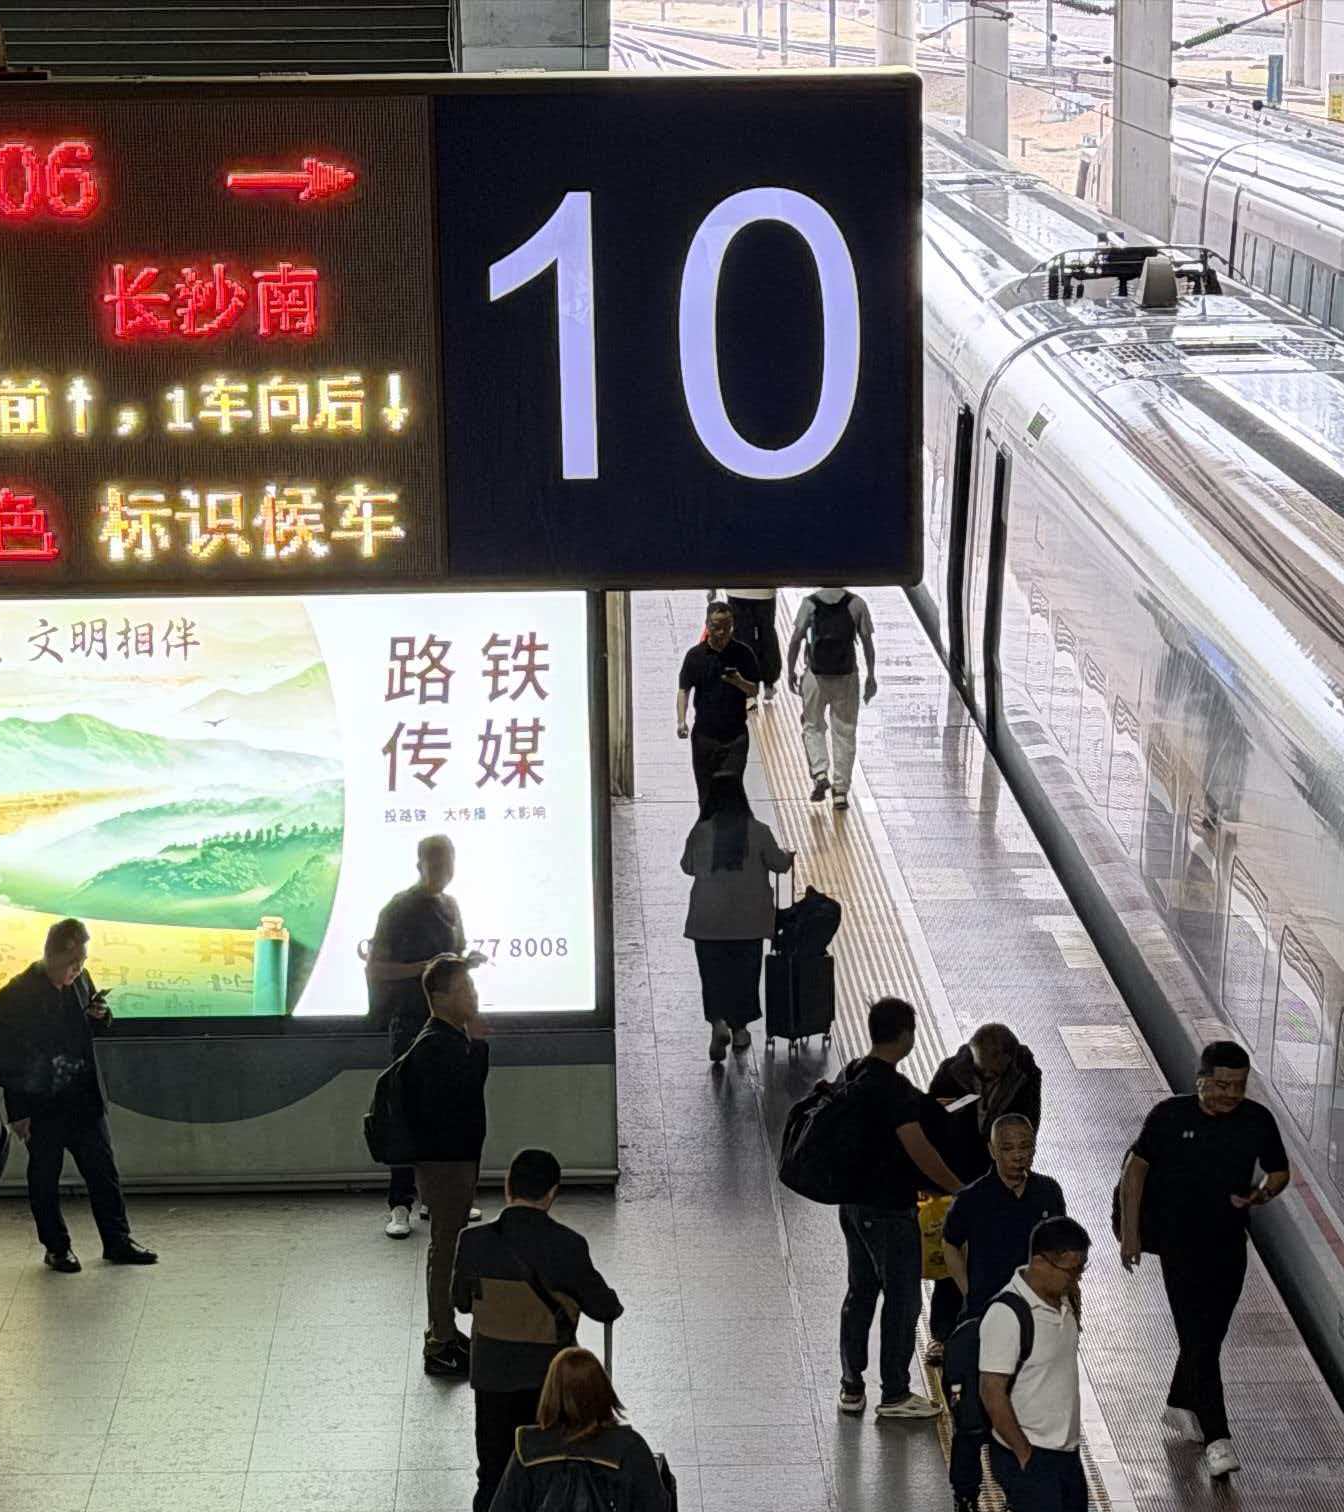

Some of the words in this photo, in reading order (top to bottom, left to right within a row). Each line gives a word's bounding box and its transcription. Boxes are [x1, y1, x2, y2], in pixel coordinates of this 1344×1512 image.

[103, 261, 319, 340] 长沙南
[489, 187, 861, 480] 10
[98, 483, 406, 562] 标识候车
[26, 617, 202, 662] 文明相伴
[384, 808, 427, 823] 投路铁
[443, 807, 487, 821] 大传播
[503, 806, 546, 820] 大影响
[509, 938, 568, 957] 8008
